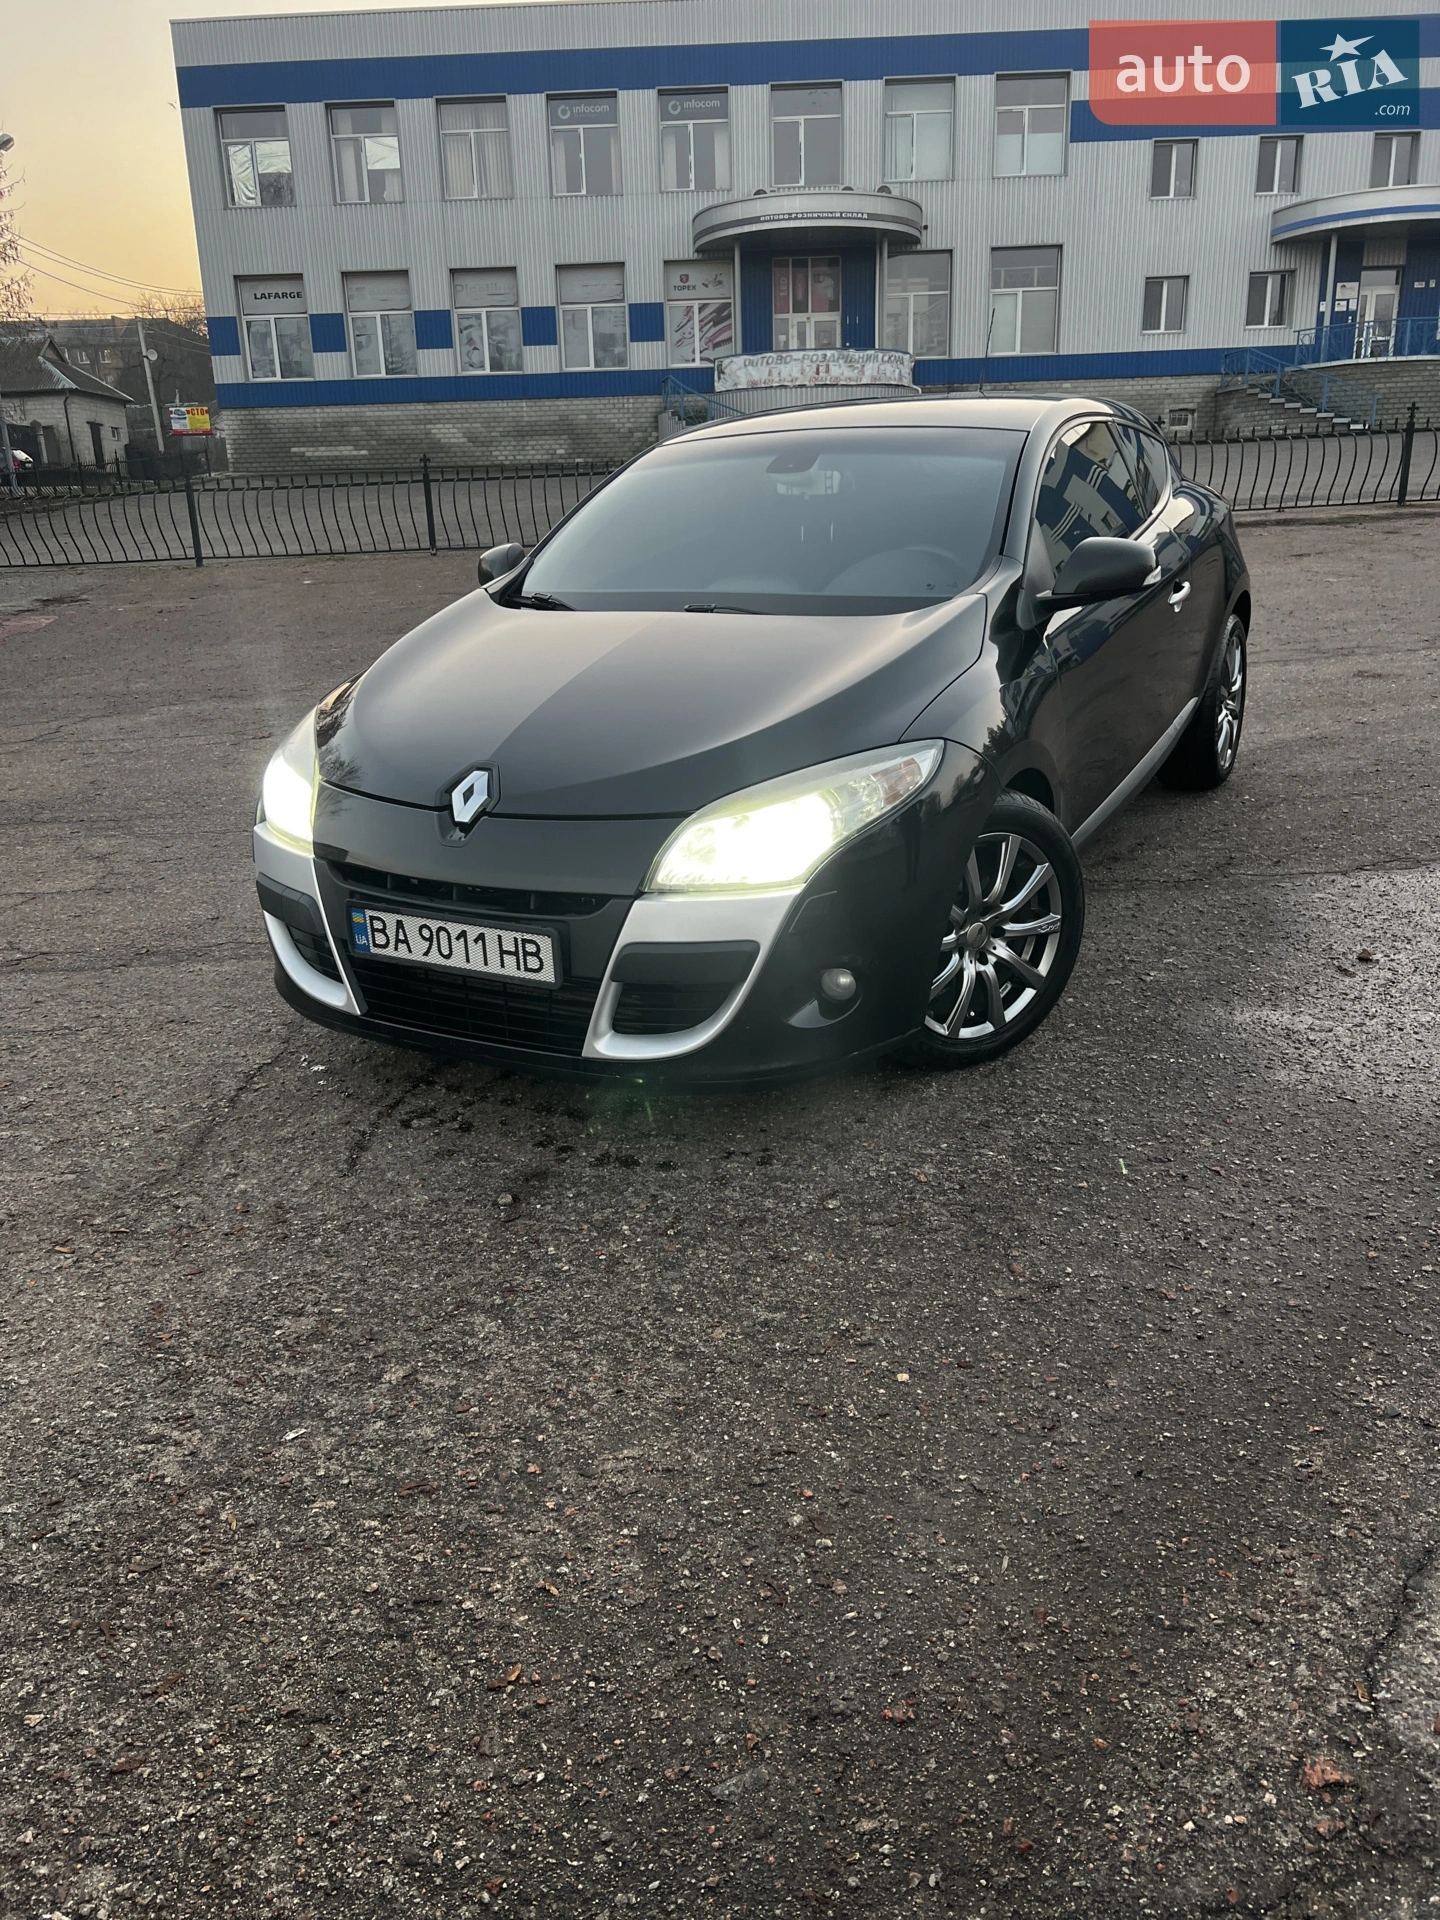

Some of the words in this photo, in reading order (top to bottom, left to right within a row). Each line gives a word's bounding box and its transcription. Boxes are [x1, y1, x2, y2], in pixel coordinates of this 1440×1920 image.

[573, 103, 610, 113] infocom
[683, 98, 720, 109] infocom
[760, 211, 840, 221] ОПТОВО-РОЗНИЧНЫЙ
[842, 211, 868, 219] СКЛАД
[254, 291, 303, 300] LAFARGE
[190, 408, 205, 416] СТО
[355, 934, 368, 946] UA
[368, 915, 412, 954] BA
[418, 923, 488, 967] 9011
[497, 934, 544, 974] HB
